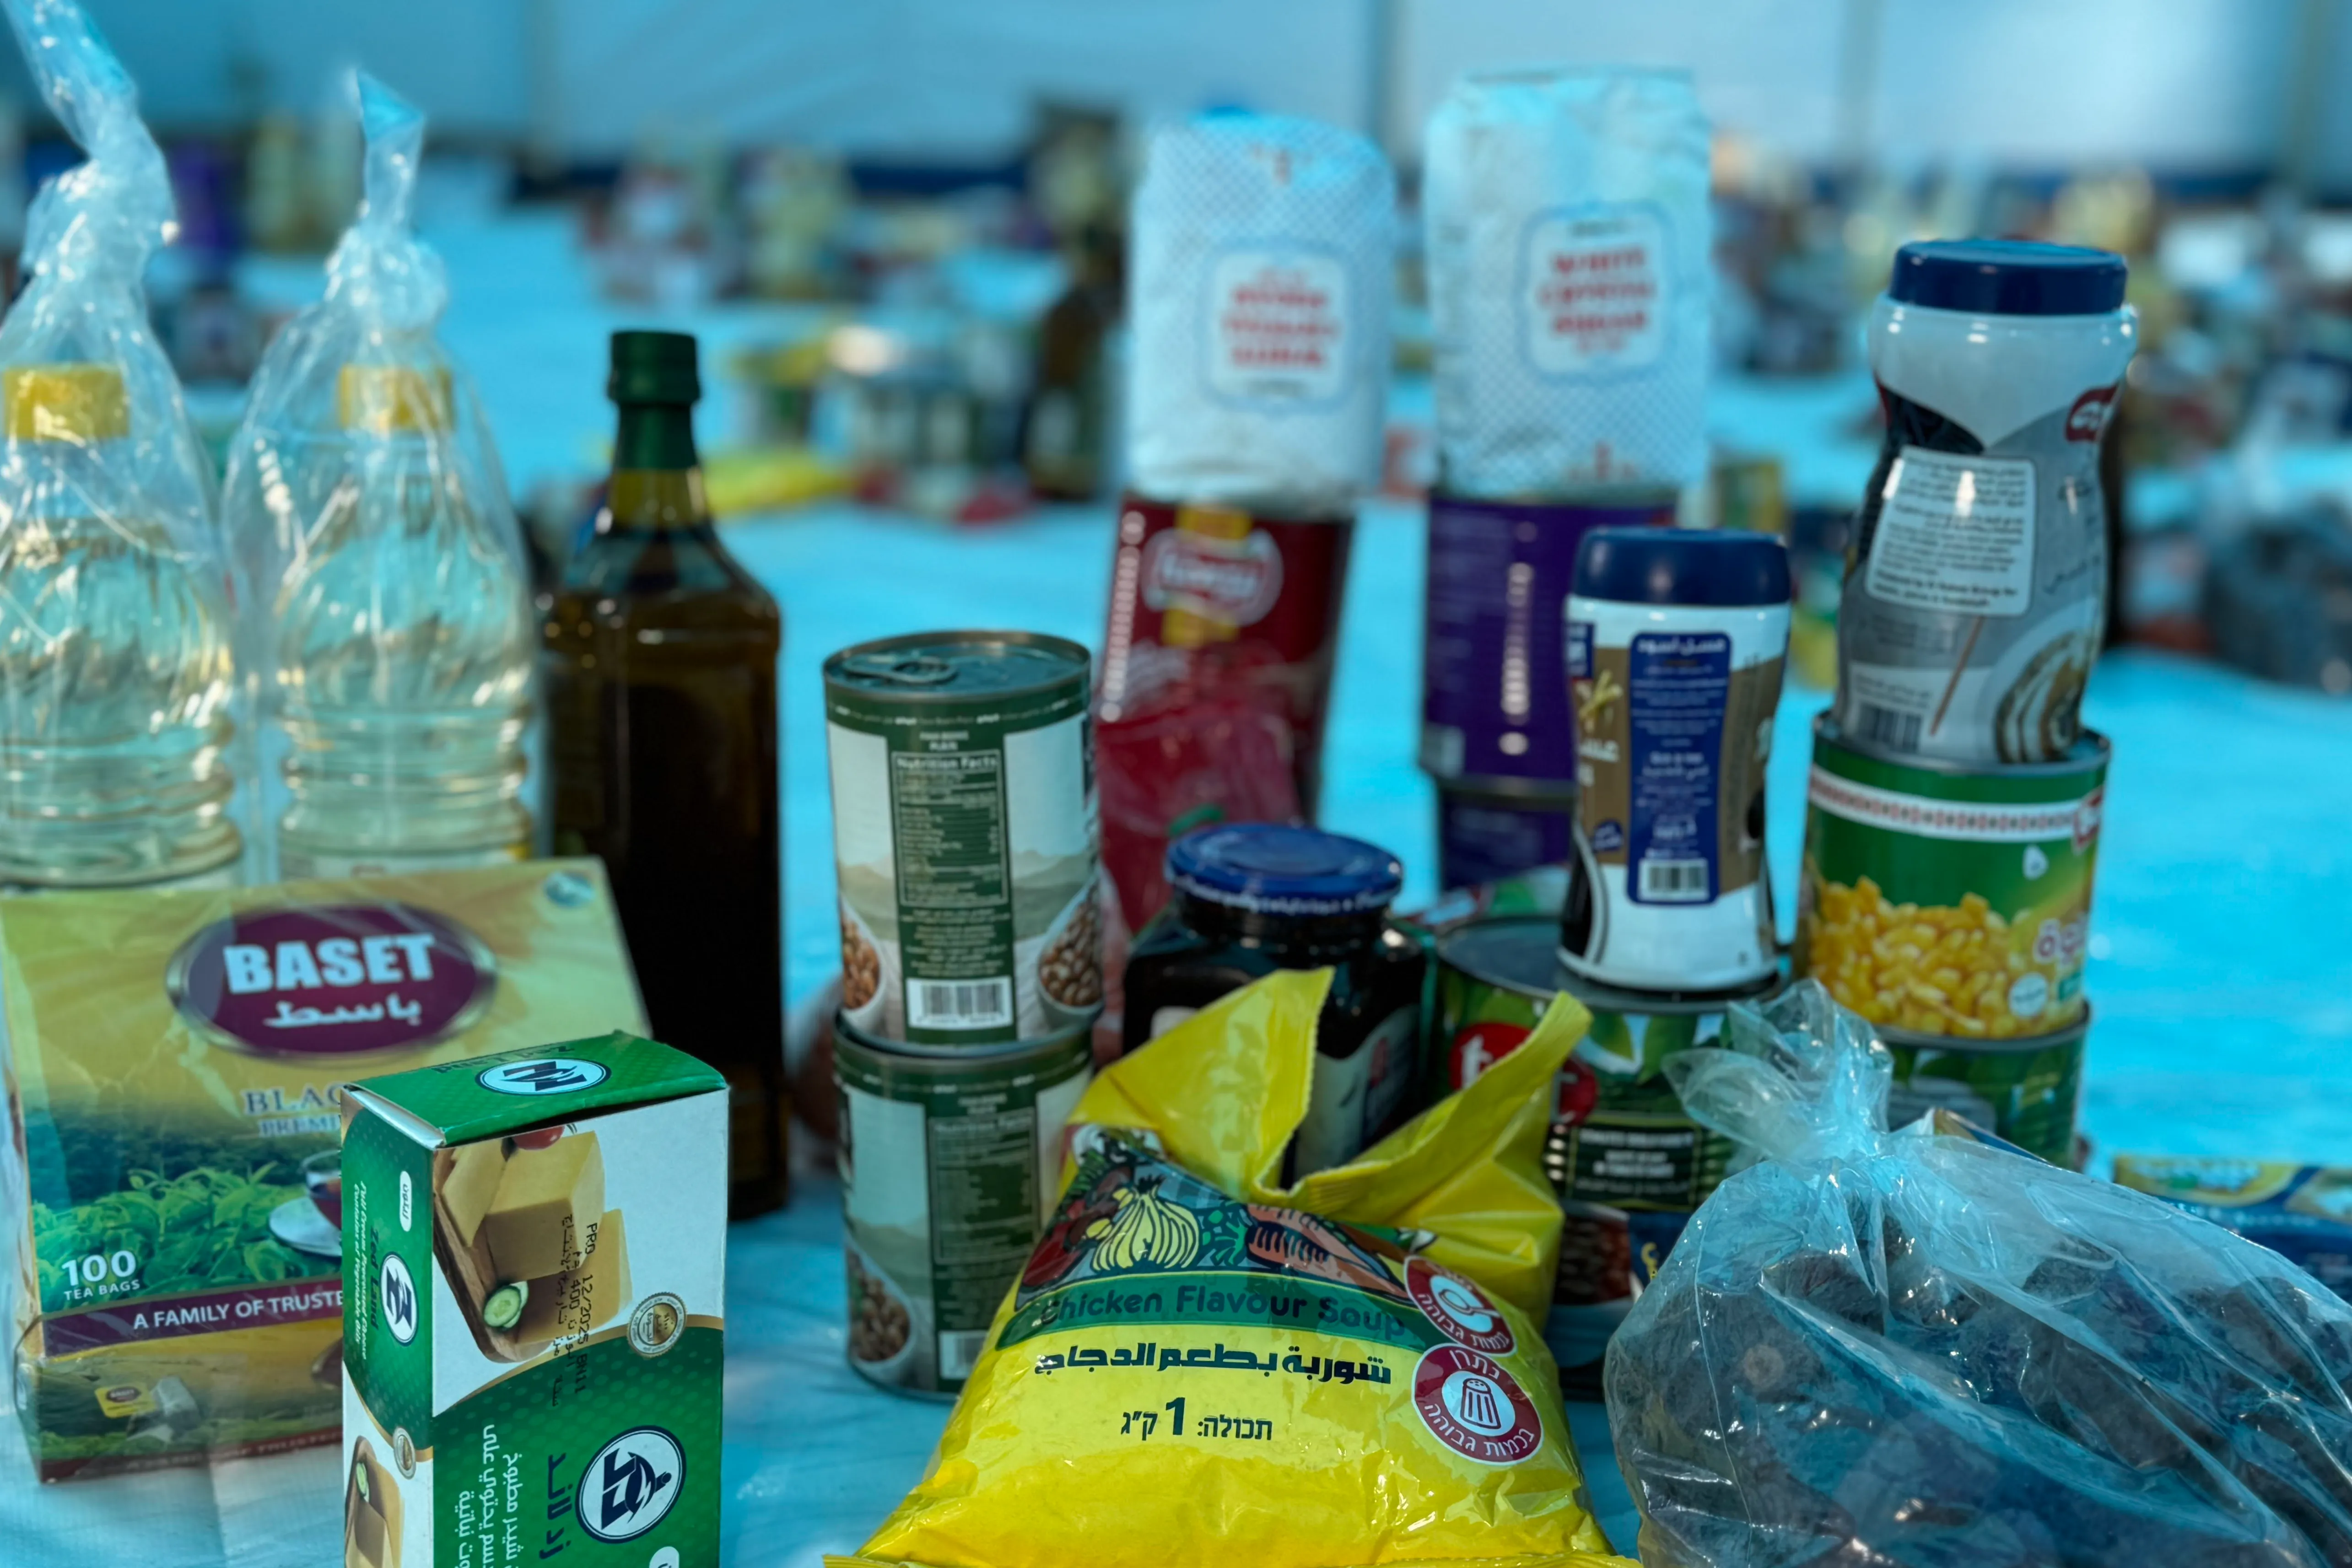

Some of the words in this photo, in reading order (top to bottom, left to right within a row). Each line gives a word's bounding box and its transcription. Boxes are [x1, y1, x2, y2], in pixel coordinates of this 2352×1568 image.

[223, 933, 434, 995] BASET
[263, 993, 421, 1028] باسط
[371, 1226, 379, 1267] Zed
[62, 1250, 136, 1286] 100
[64, 1288, 93, 1300] TEA
[99, 1279, 140, 1295] BAGS
[371, 1275, 379, 1330] Land
[569, 1280, 581, 1310] 400
[133, 1313, 148, 1329] A
[153, 1304, 230, 1327] FAMILY
[236, 1300, 264, 1318] OF
[578, 1275, 593, 1345] 12/2025
[1041, 1290, 1162, 1324] Chicken
[1176, 1286, 1307, 1318] Flavour
[1318, 1297, 1405, 1340] Soup
[1417, 1293, 1464, 1340] גבוהה
[1035, 1342, 1156, 1375] الدجاج
[1157, 1343, 1278, 1377] بطعم
[1282, 1346, 1391, 1384] شوربة
[1165, 1397, 1185, 1435] 1
[1198, 1414, 1273, 1440] תכולה:
[1424, 1403, 1476, 1451] גבוהה
[482, 1425, 500, 1464] على
[1484, 1428, 1535, 1457] בכמות
[478, 1468, 498, 1530] يحتوي
[502, 1453, 523, 1512] مطبوخ
[454, 1491, 476, 1537] نباتية
[502, 1517, 524, 1560] شيدر
[539, 1527, 575, 1559] زد
